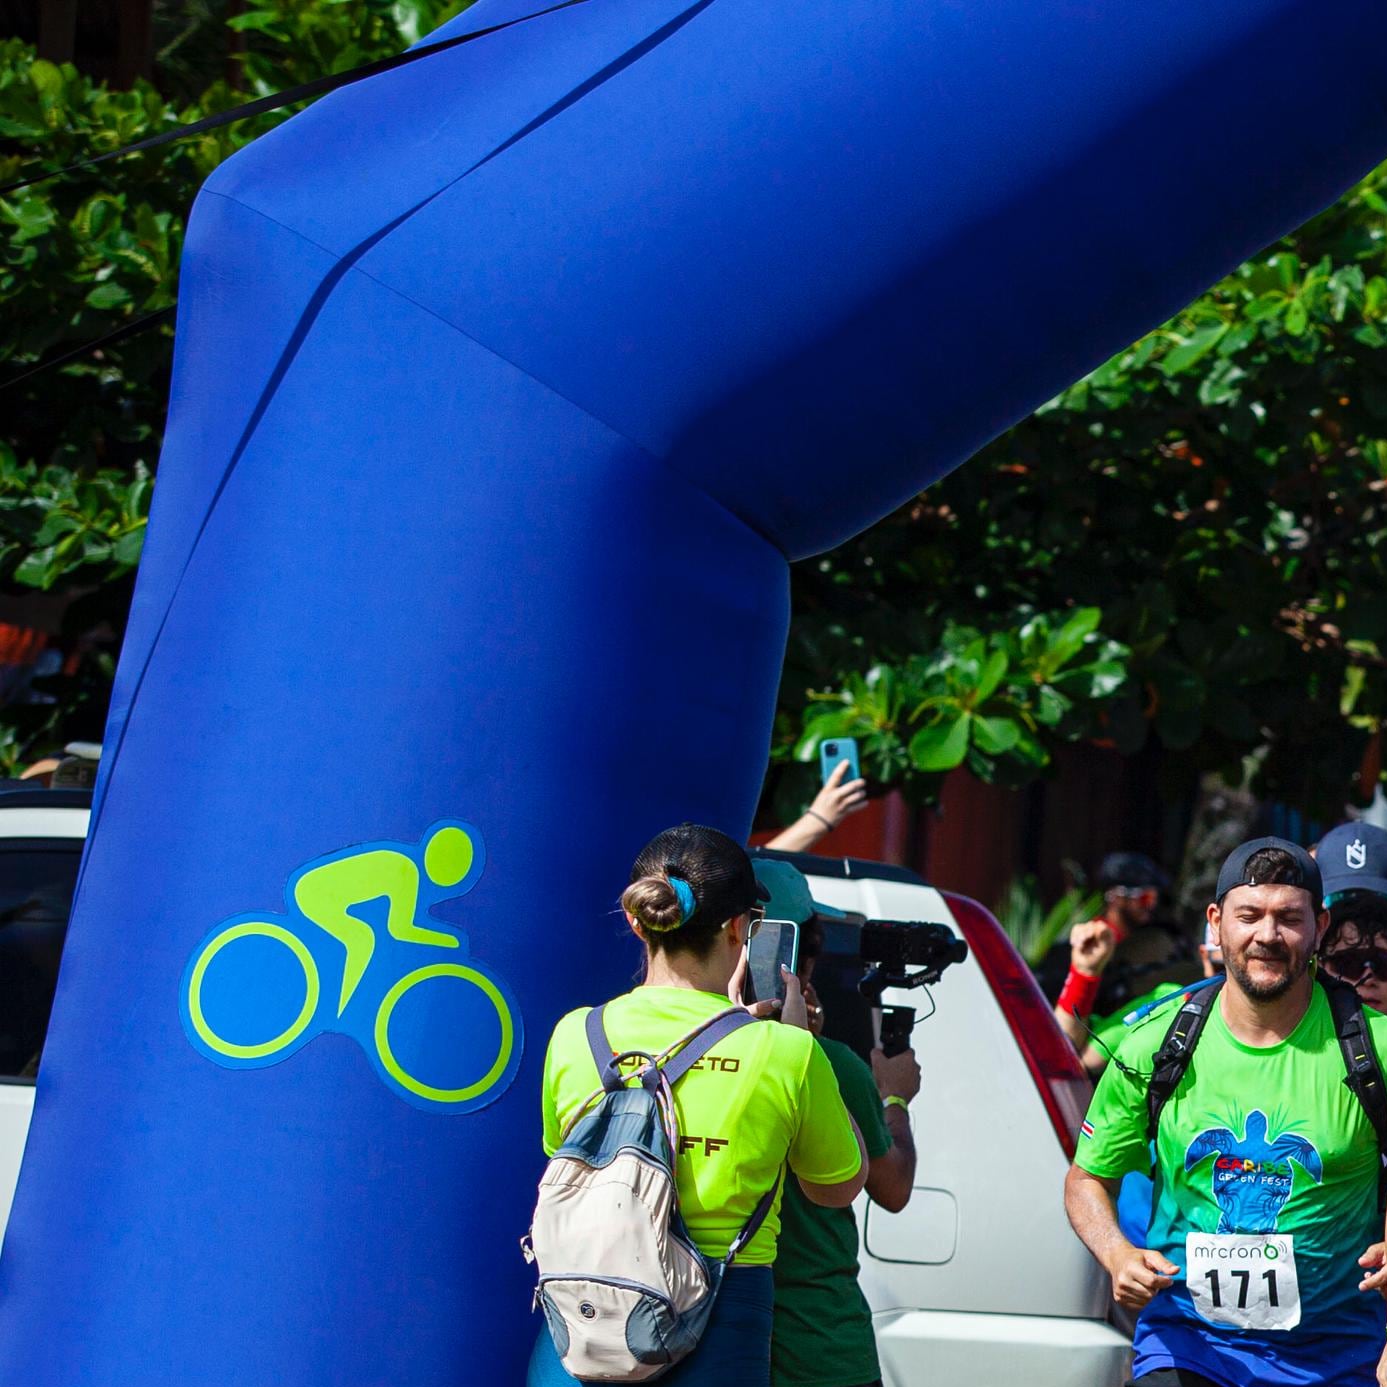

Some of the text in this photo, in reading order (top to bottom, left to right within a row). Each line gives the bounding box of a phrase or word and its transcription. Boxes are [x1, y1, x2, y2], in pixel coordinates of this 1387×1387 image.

[1216, 1158, 1291, 1176] CARIBE
[1261, 1176, 1290, 1187] FEST
[1204, 1268, 1280, 1309] 171
